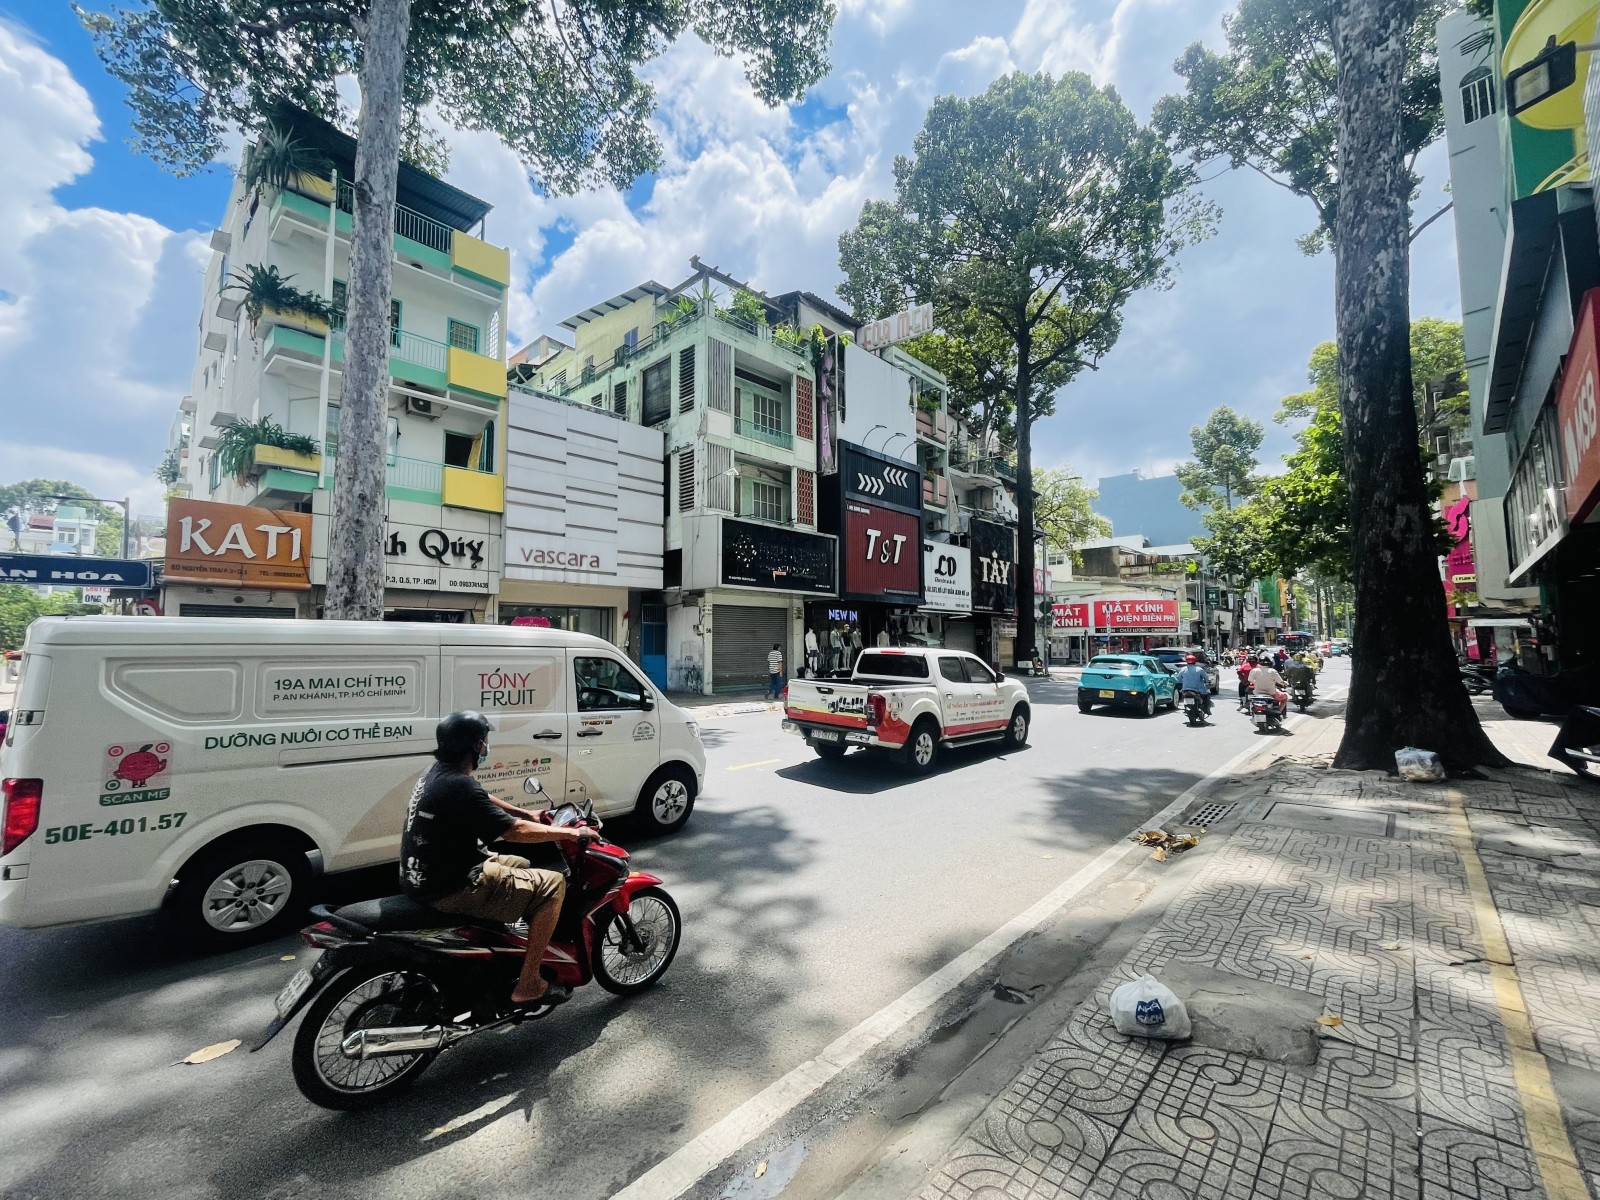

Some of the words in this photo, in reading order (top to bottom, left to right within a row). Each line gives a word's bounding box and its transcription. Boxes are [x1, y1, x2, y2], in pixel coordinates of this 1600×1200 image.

[179, 515, 302, 562] KATI
[520, 547, 600, 568] vascara
[828, 608, 848, 620] NEW
[849, 610, 858, 621] IN
[1135, 602, 1164, 613] KÍNH
[1053, 616, 1083, 627] KÍNH
[1116, 614, 1140, 624] ĐIỆN
[1142, 613, 1162, 622] BIÊN
[274, 678, 305, 691] 19A
[308, 677, 340, 690] MAI
[344, 674, 372, 688] CHÍ
[375, 675, 406, 689] THỌ
[282, 693, 297, 701] AN
[299, 691, 337, 700] KHÁNH,
[366, 689, 382, 697] CHÍ
[383, 688, 406, 696] MINH
[480, 688, 536, 707] FRUIT
[205, 732, 277, 749] DƯỠNG
[280, 728, 322, 744] NUÔI
[325, 727, 350, 741] CƠ
[352, 722, 381, 739] THỂ
[383, 725, 413, 740] BẠN
[102, 792, 143, 805] SCAN
[147, 789, 168, 800] ME
[44, 812, 188, 845] 50E-401.57
